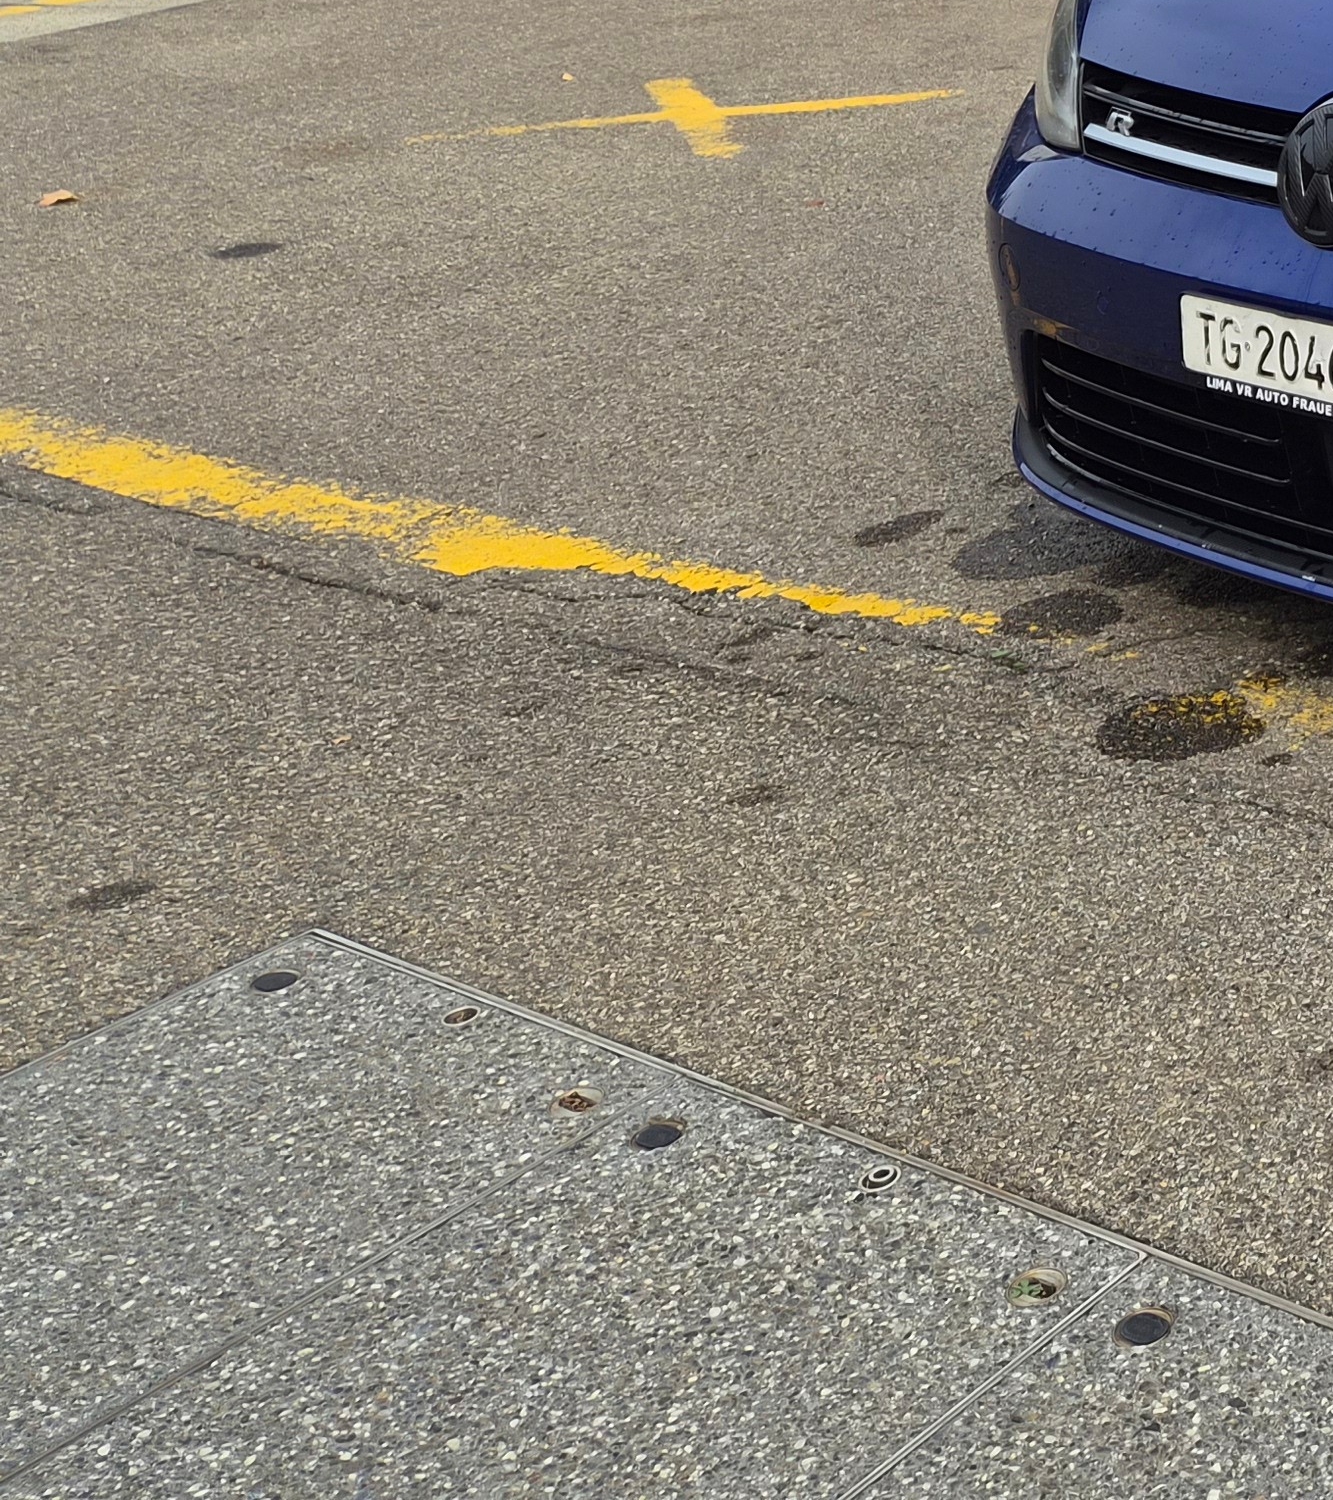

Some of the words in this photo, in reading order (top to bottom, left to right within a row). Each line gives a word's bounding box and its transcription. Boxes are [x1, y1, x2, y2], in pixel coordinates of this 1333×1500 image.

[1106, 106, 1134, 136] R
[1206, 376, 1232, 393] LIMA
[1236, 383, 1252, 397] VR
[1255, 389, 1289, 406] AUTO
